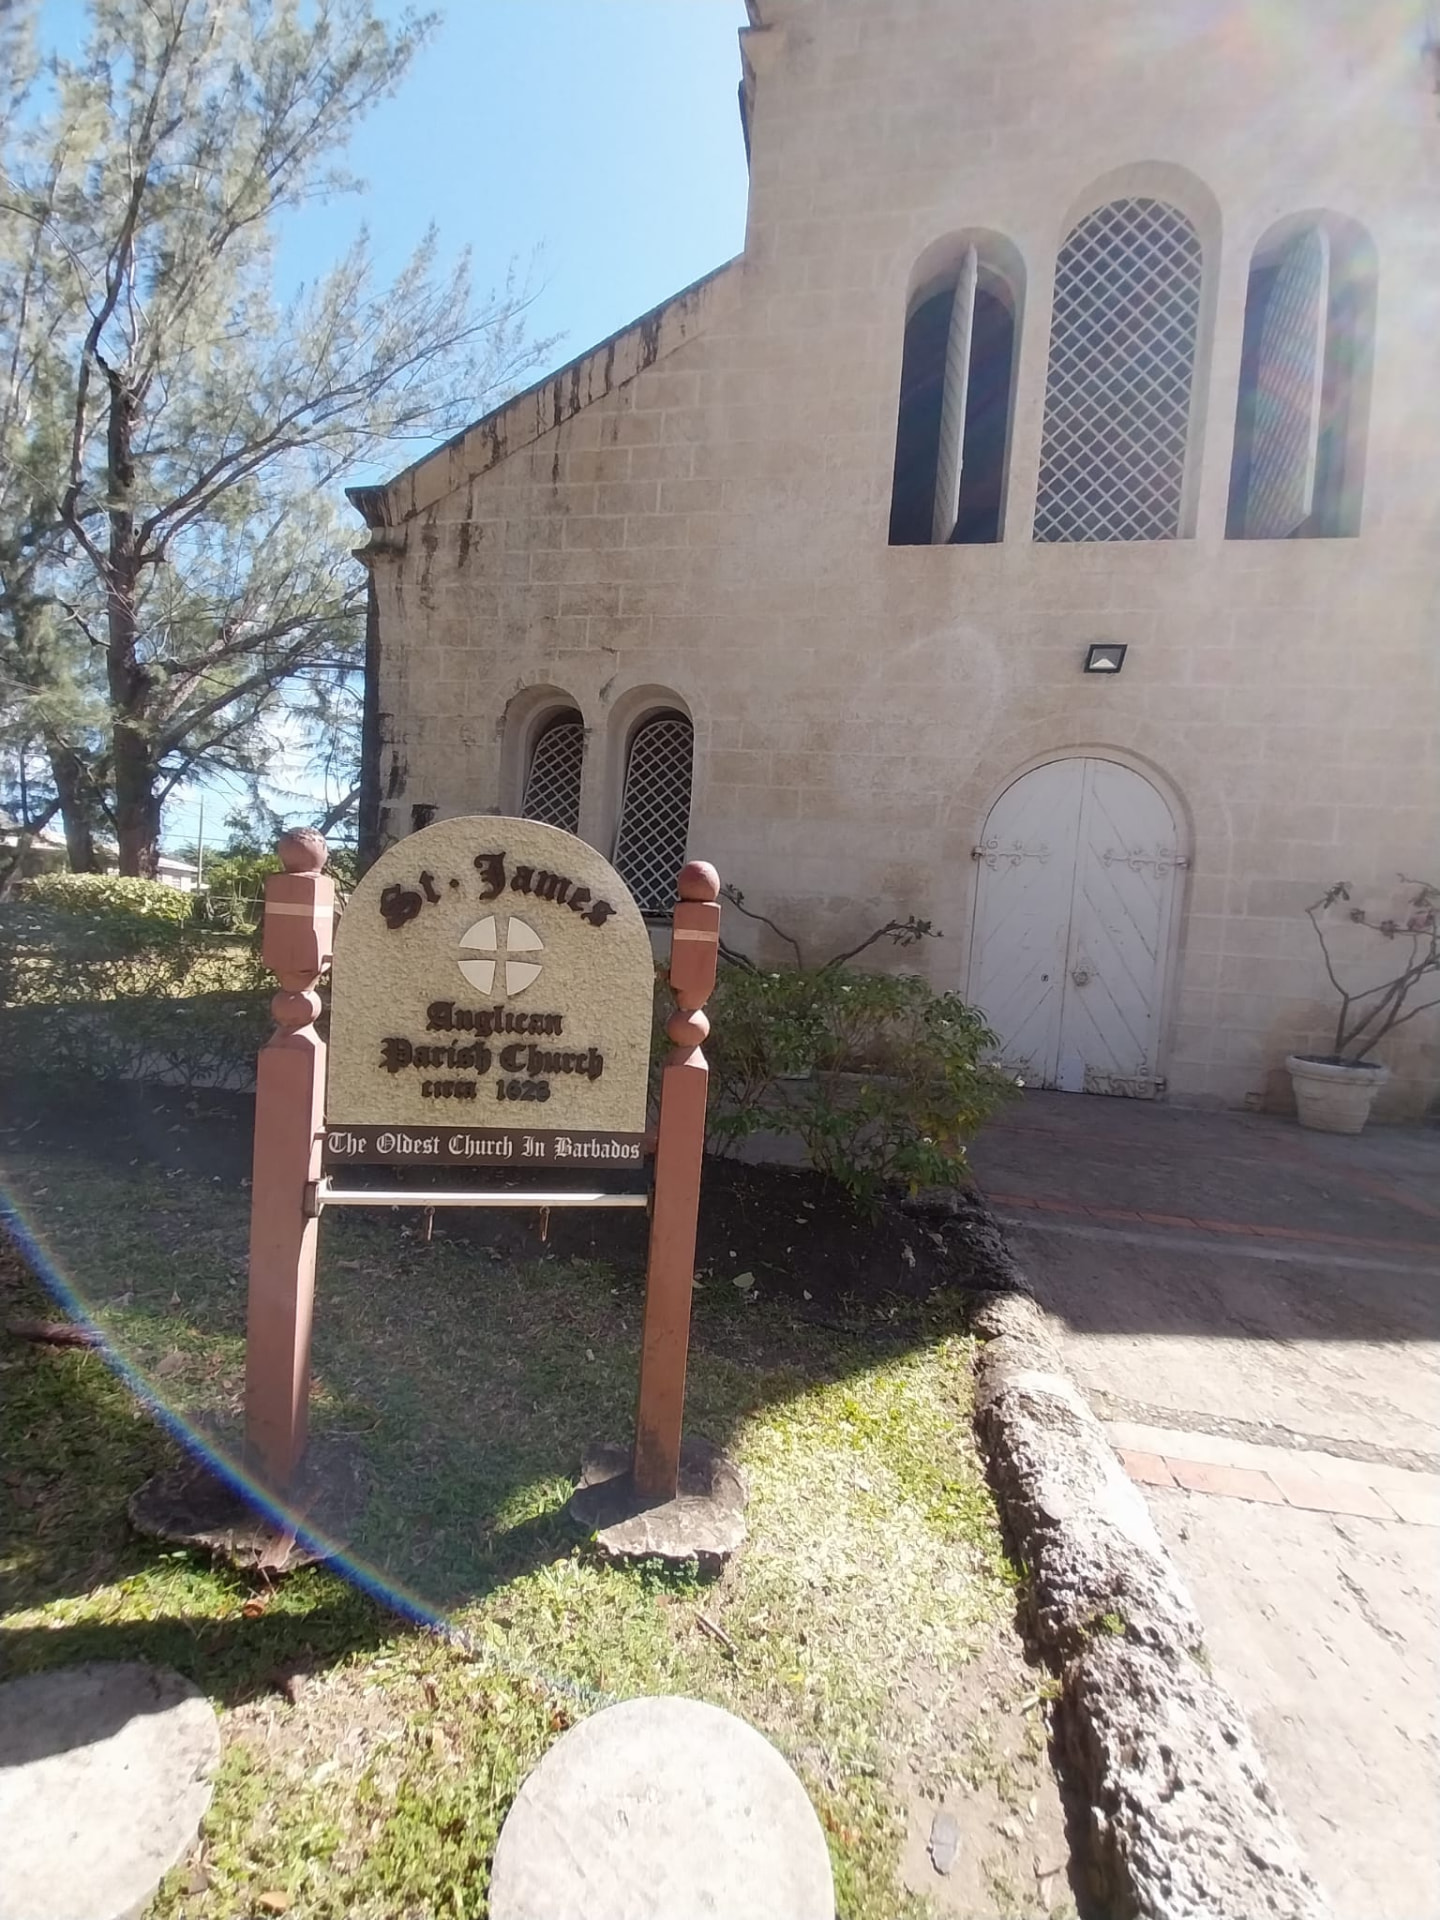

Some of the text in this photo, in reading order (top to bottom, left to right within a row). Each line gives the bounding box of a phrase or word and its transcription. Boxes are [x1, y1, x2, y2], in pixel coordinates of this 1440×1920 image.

[473, 850, 617, 927] James
[426, 1001, 563, 1037] Anglican
[378, 1037, 604, 1081] Parish Church
[421, 1079, 551, 1102] circa 1628
[327, 1131, 641, 1161] The Oldest Church In Barbados
